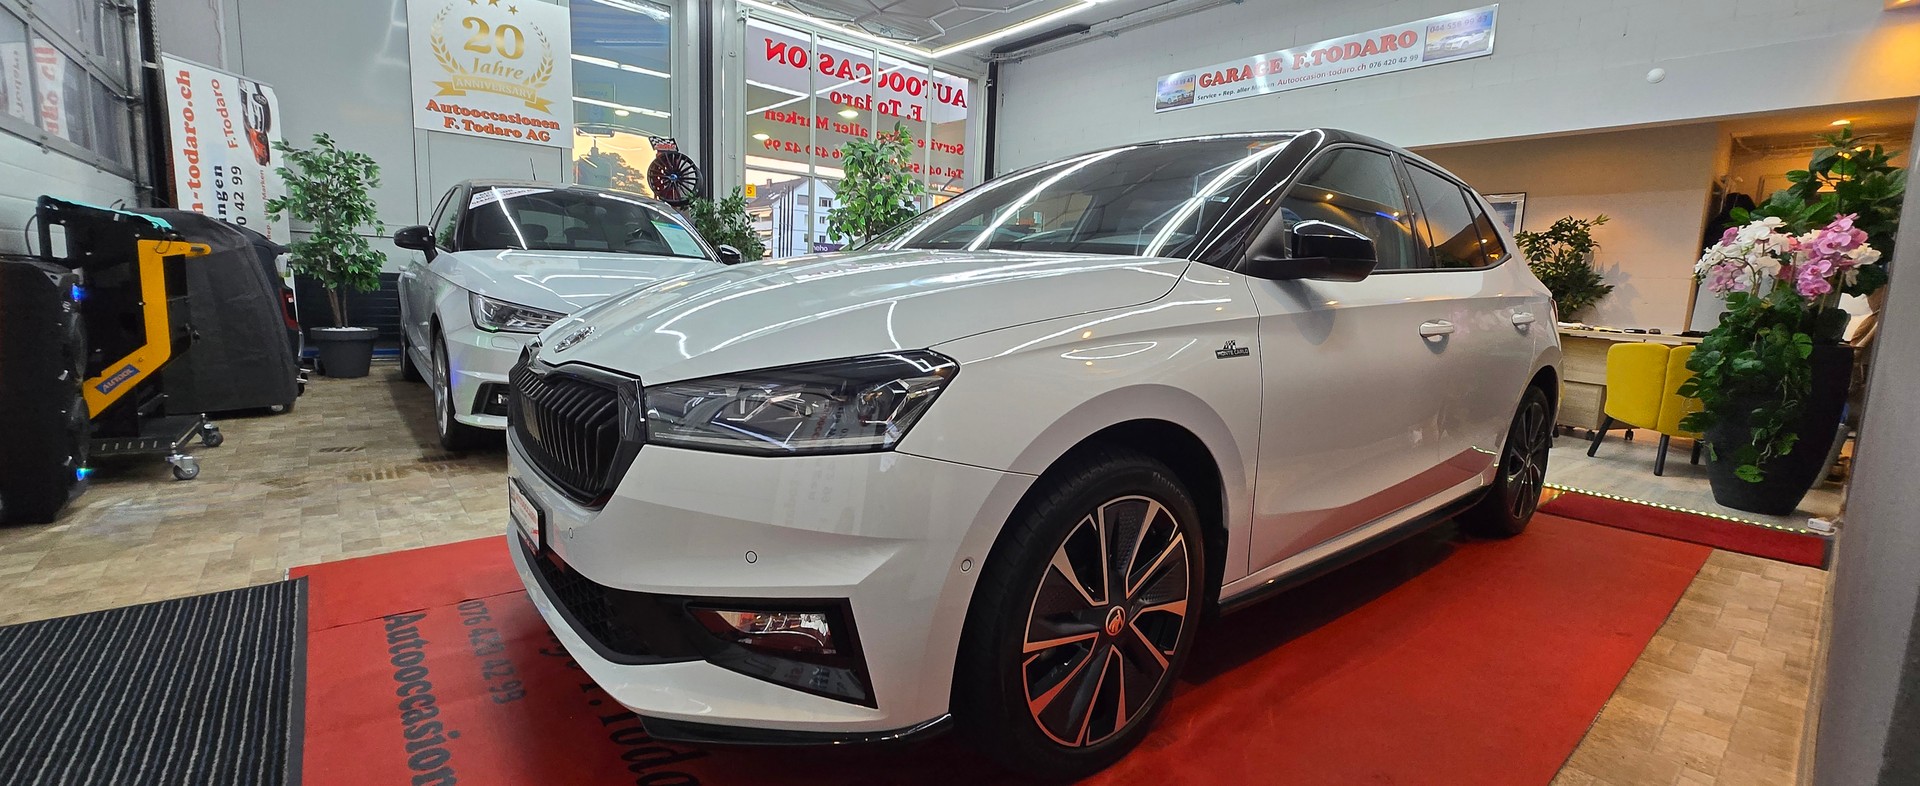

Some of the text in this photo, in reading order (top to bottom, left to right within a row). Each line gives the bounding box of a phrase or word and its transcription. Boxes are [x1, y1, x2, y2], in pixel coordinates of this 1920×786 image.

[462, 16, 525, 60] 20
[472, 57, 524, 80] Jahre
[1199, 30, 1418, 88] GARAGE F.TODARO
[1369, 61, 1382, 69] 076
[1383, 58, 1397, 66] 420
[456, 77, 534, 99] ANNIVERSARY
[425, 99, 561, 131] Autooccasionen
[443, 116, 551, 142] F. Todaro AG
[231, 166, 243, 186] 99
[233, 191, 245, 212] 42
